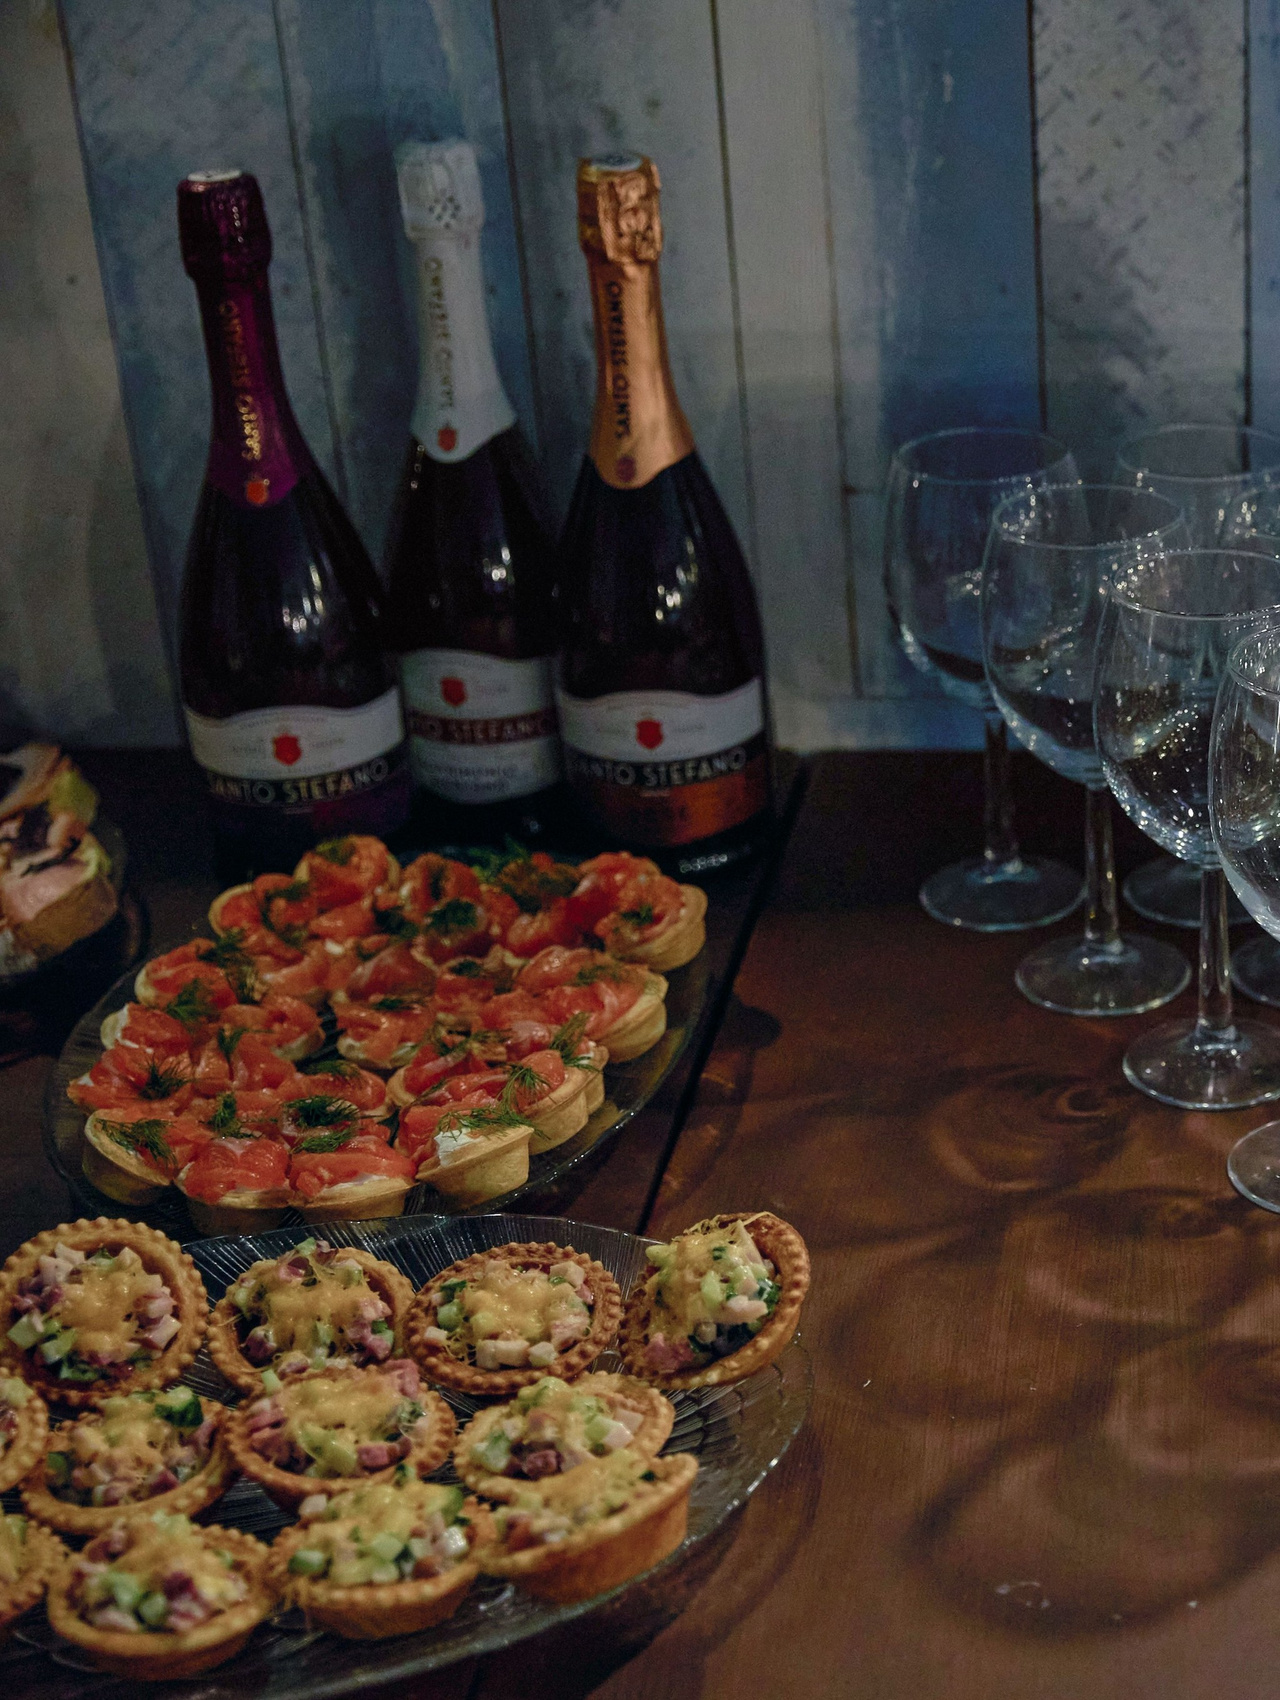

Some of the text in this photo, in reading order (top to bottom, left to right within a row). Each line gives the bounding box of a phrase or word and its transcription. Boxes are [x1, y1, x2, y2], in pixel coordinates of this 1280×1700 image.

[605, 280, 631, 440] SANTO STEFANO
[282, 756, 389, 803] STEFANO
[642, 745, 748, 786] STEFANO
